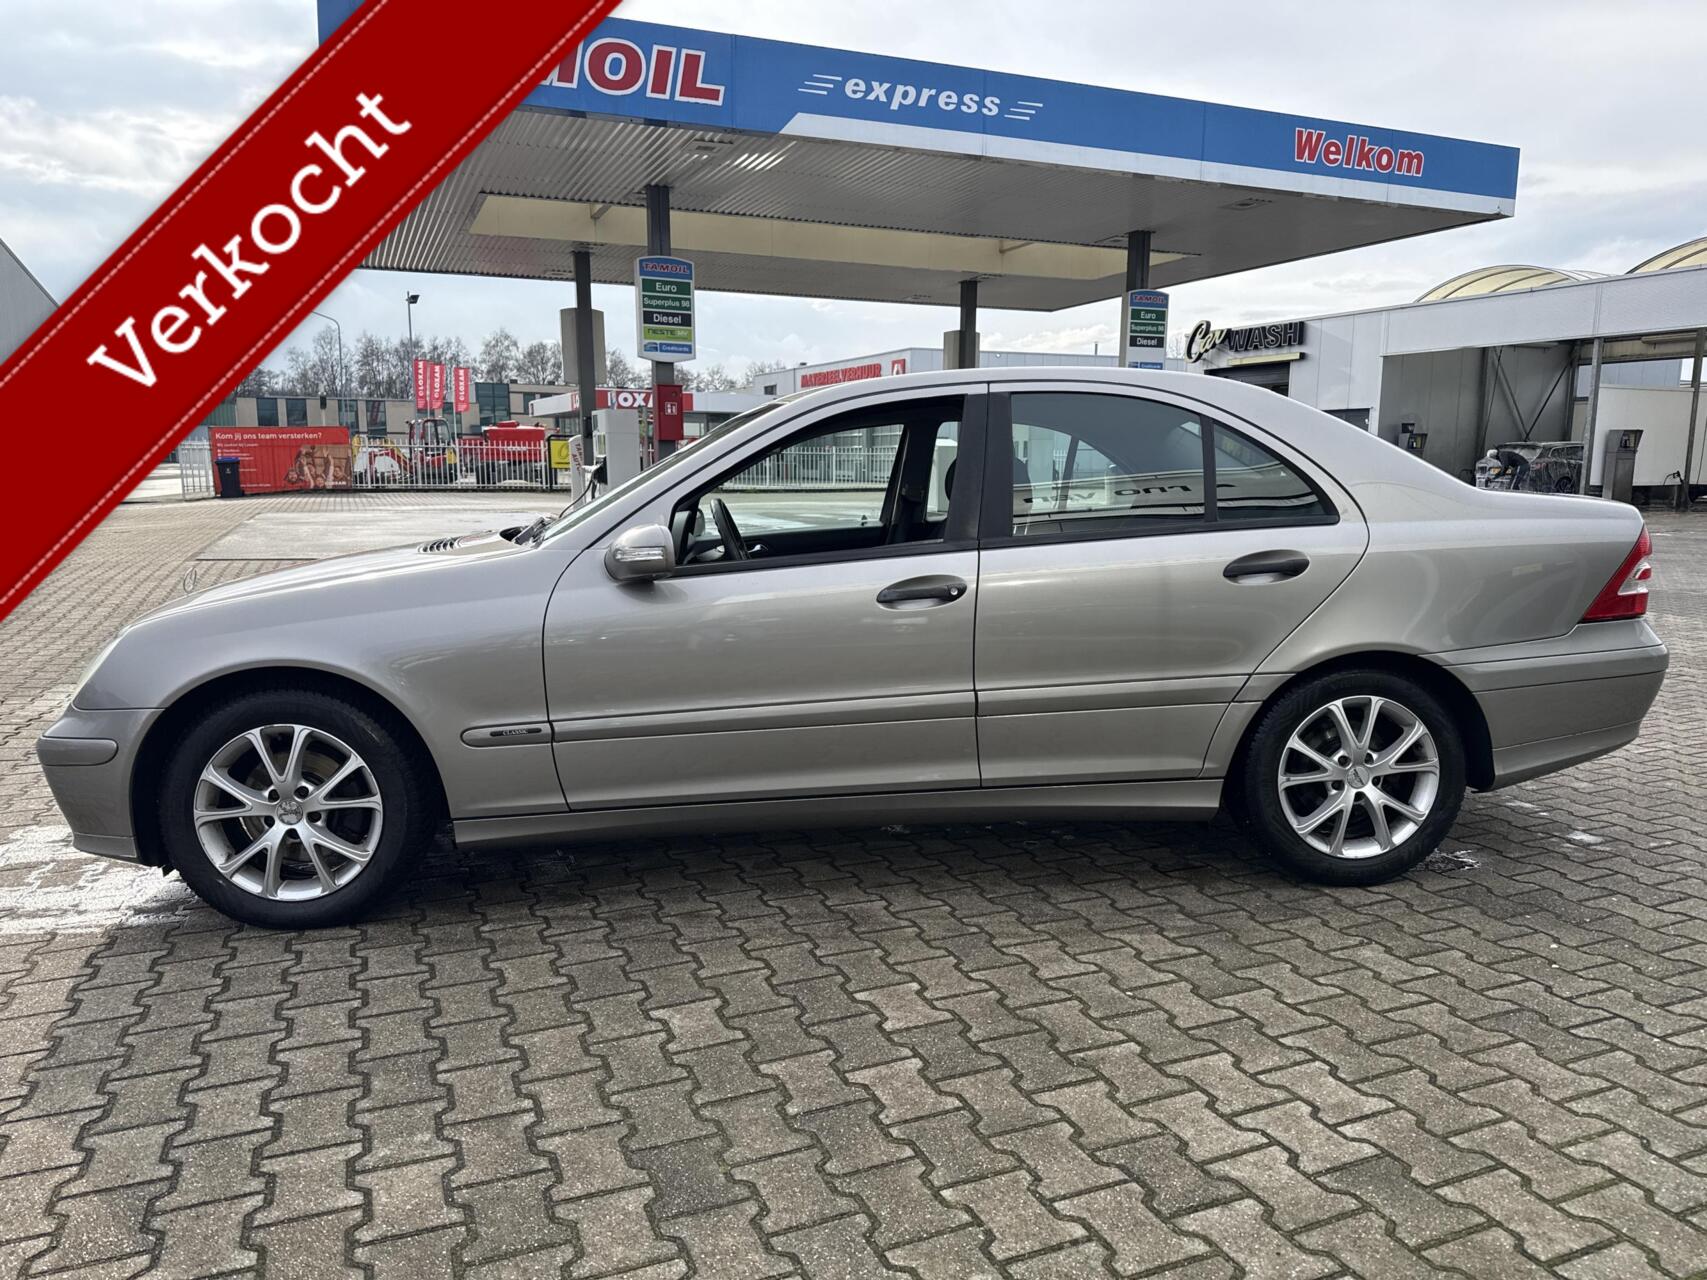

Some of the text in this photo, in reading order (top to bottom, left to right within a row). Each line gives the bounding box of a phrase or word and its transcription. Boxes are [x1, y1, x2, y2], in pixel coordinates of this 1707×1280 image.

[844, 77, 1001, 117] express
[1294, 127, 1425, 177] Welkom
[643, 263, 689, 274] TAMOIL
[655, 282, 677, 292] Euro
[643, 297, 680, 307] Superplus
[653, 314, 682, 324] Diesel
[1140, 311, 1156, 320] Euro
[1136, 337, 1158, 346] Diesel
[1184, 320, 1304, 363] Car WASH
[215, 432, 233, 440] Kom
[234, 432, 242, 441] jij
[278, 432, 322, 440] versterken?
